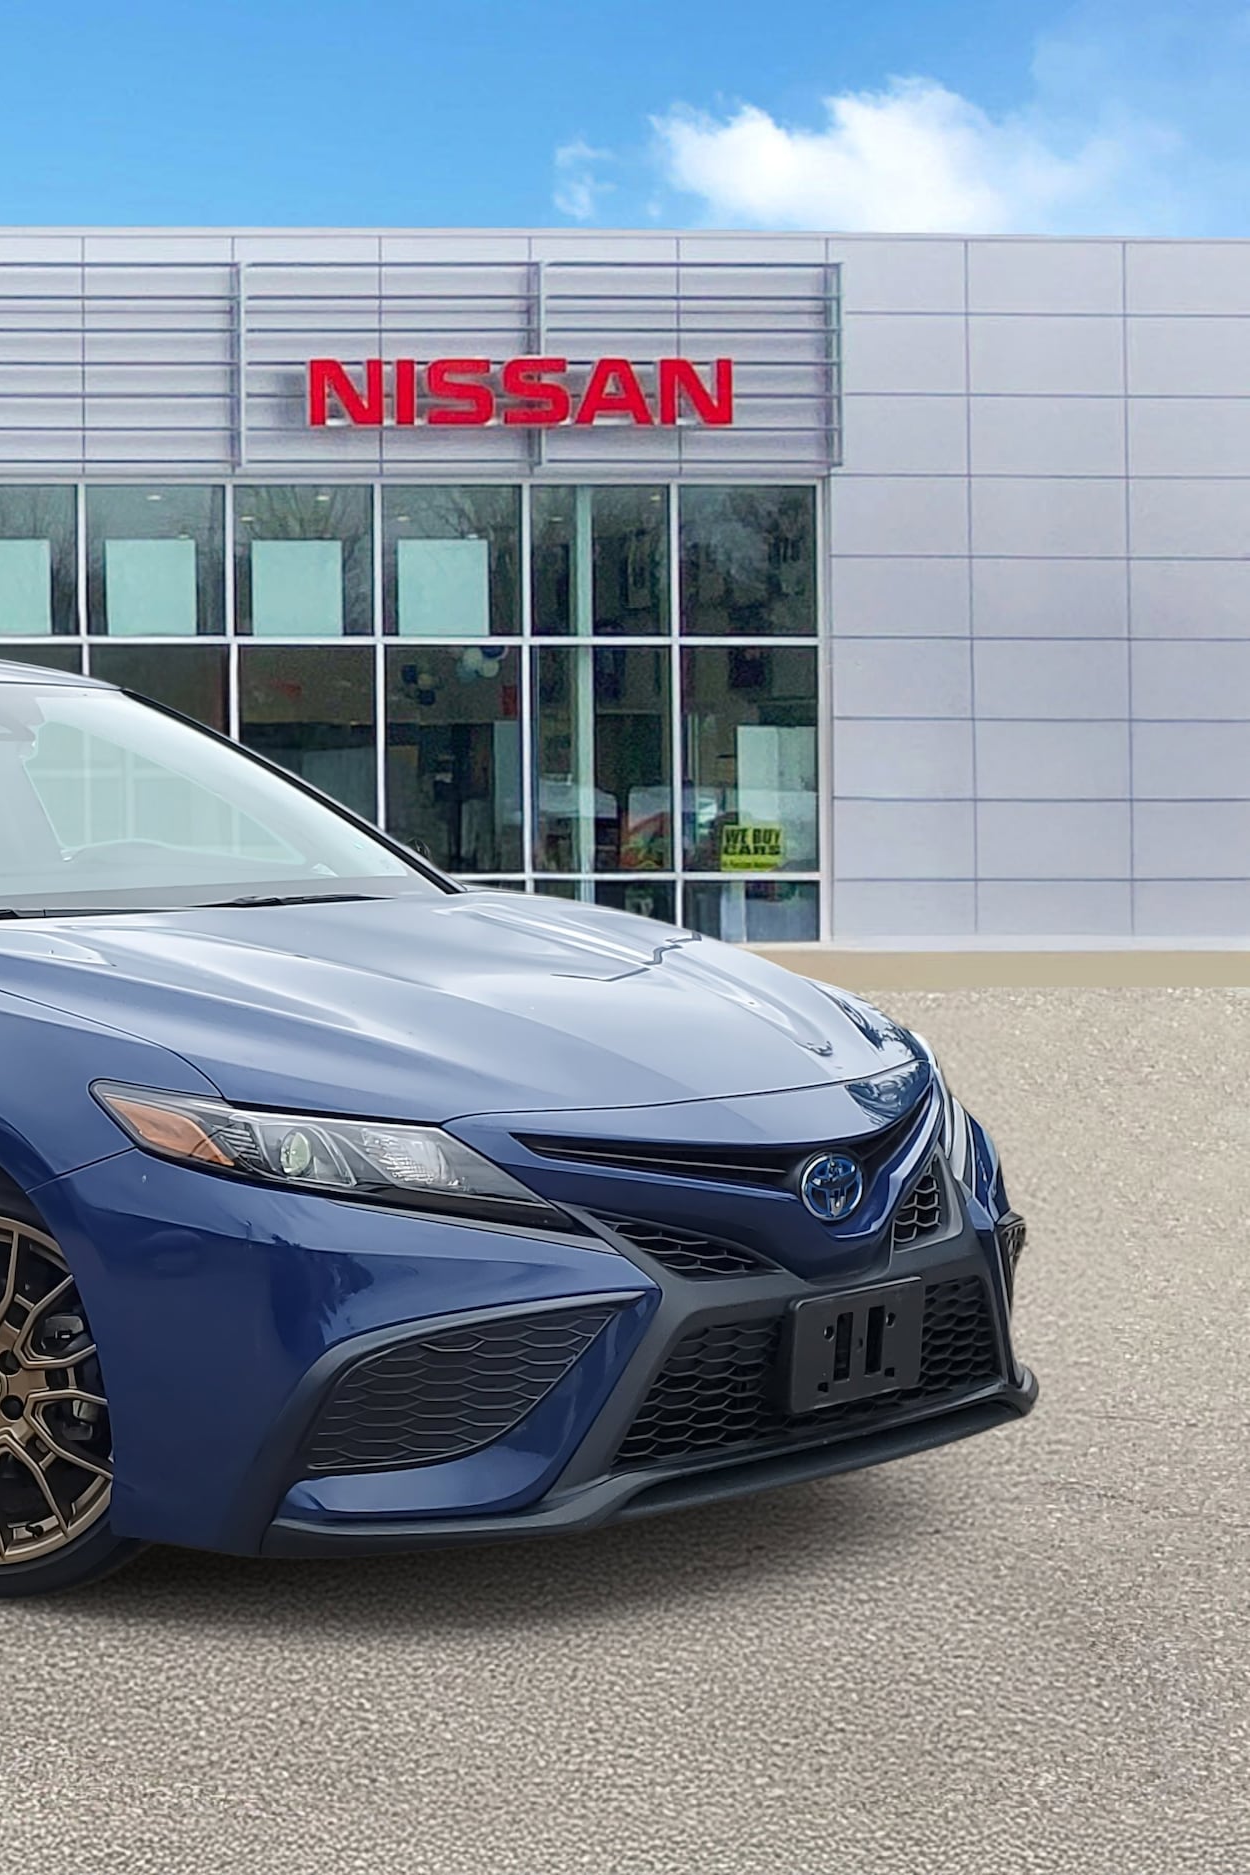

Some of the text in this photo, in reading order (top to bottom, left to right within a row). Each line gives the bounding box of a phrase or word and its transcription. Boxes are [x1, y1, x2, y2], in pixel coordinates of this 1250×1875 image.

[308, 357, 734, 426] NISSAN
[724, 828, 782, 844] WE BUY
[723, 844, 781, 856] CARS
